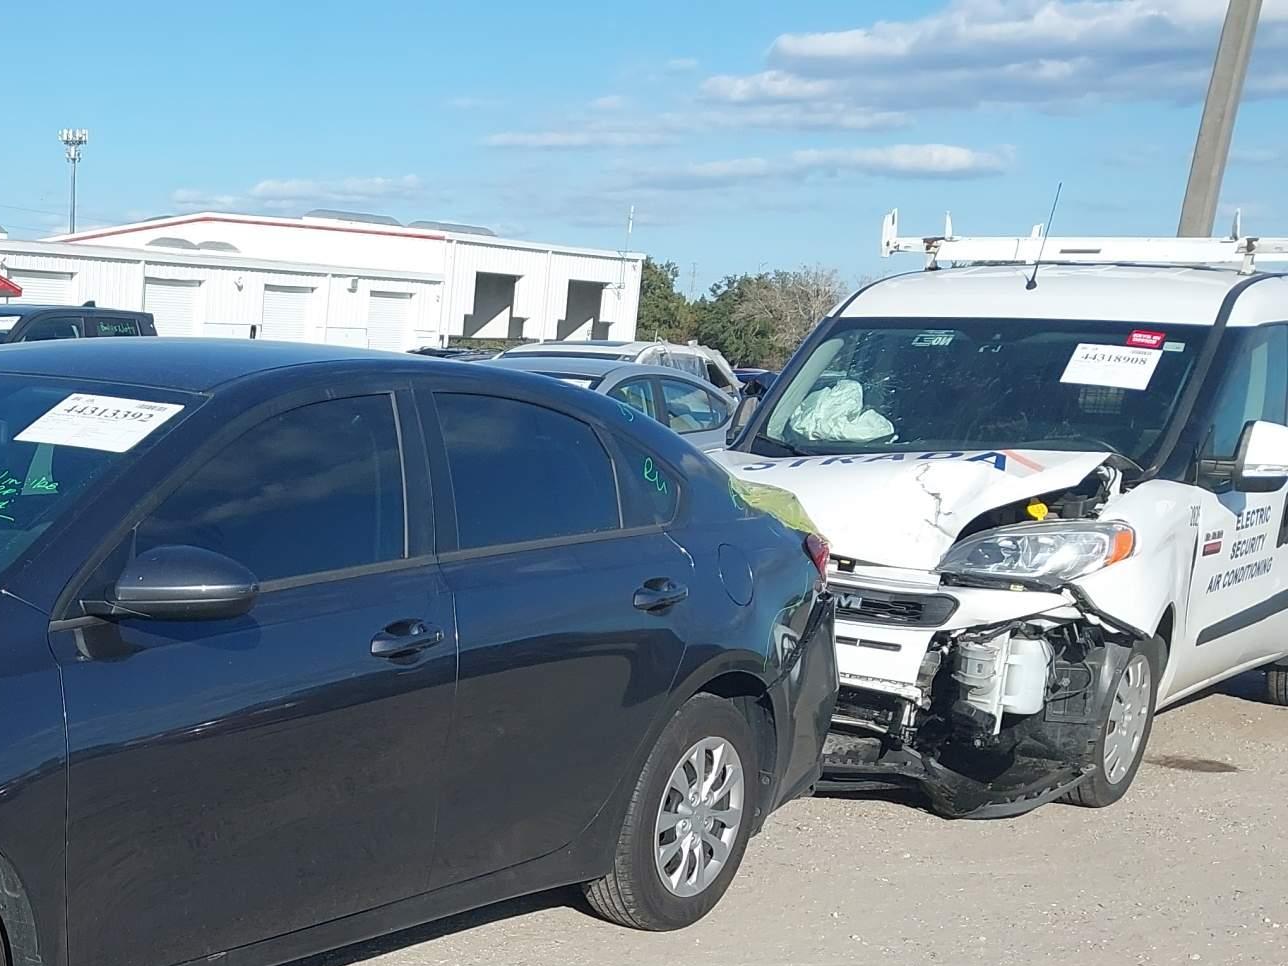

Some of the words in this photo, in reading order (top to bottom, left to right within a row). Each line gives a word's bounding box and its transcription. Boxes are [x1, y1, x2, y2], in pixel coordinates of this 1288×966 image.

[1081, 353, 1148, 366] 44318908
[64, 404, 155, 423] 44313392
[743, 451, 1008, 472] STRADA
[1235, 506, 1272, 531] ELECTRIC
[1230, 533, 1267, 560] SECURITY
[1206, 573, 1222, 594] AIR
[1222, 556, 1273, 589] CONDITIONING
